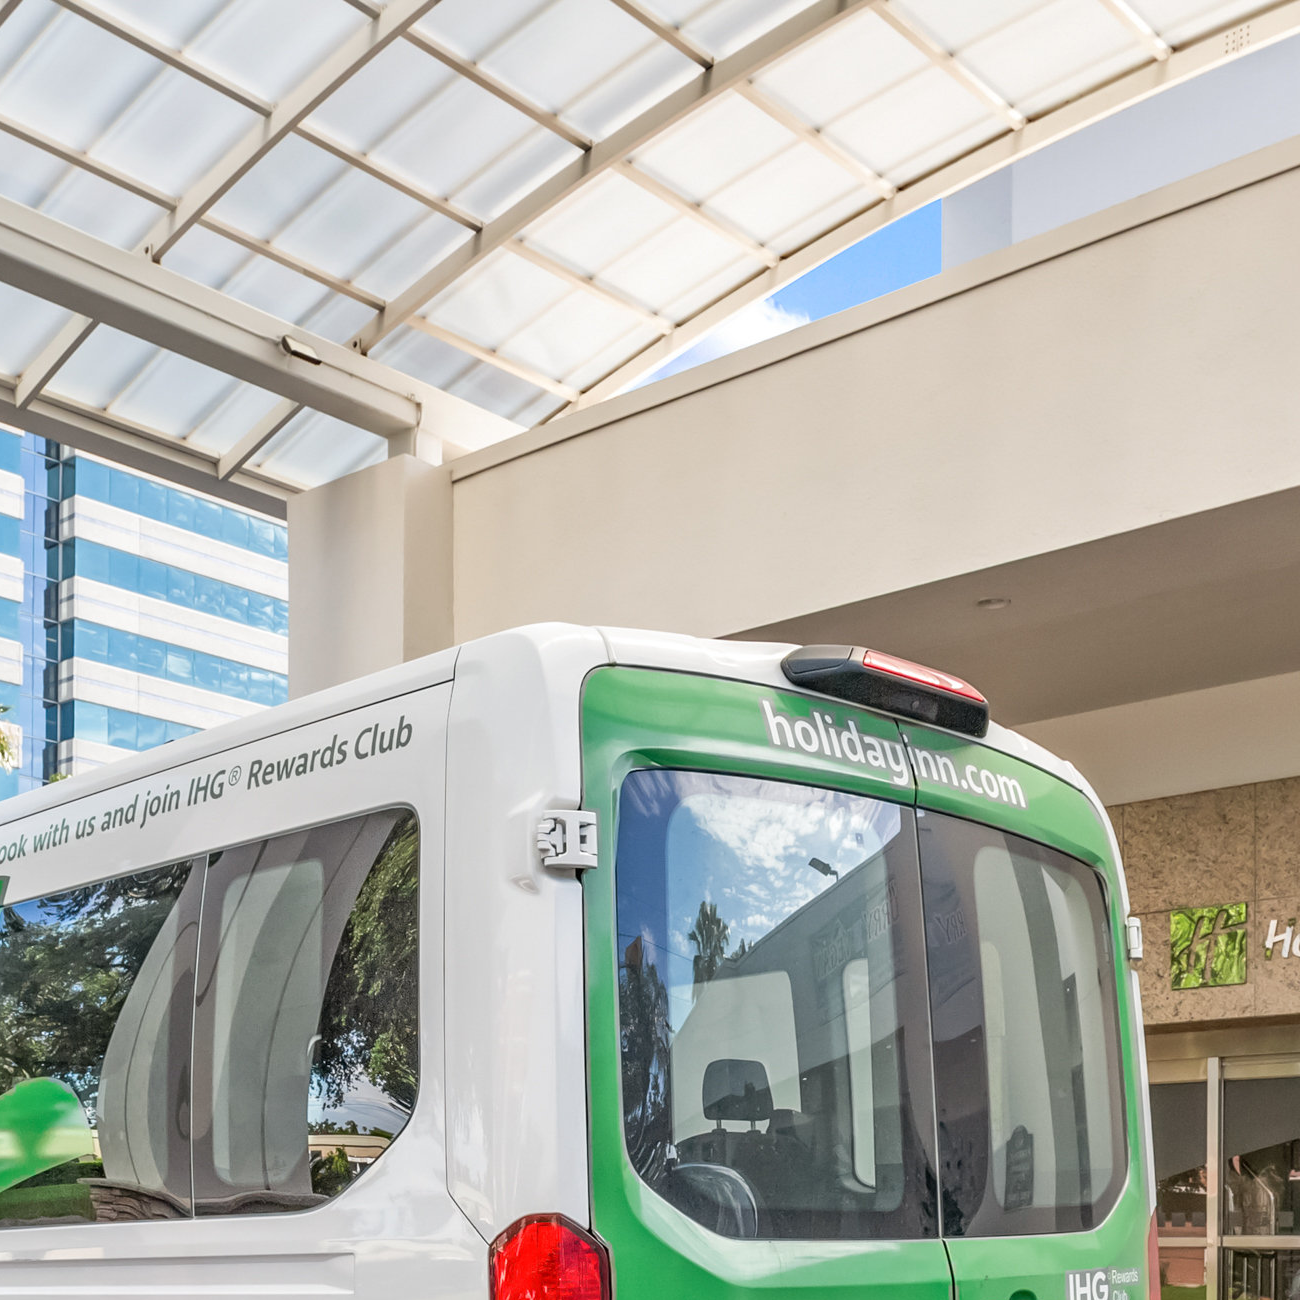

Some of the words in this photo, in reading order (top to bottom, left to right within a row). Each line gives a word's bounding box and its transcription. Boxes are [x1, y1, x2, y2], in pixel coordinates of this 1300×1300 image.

[33, 817, 69, 853] with
[75, 813, 95, 837] us
[101, 794, 136, 832] and
[140, 783, 180, 829] join
[247, 734, 349, 790] Rewards
[354, 715, 413, 760] Club
[762, 699, 1027, 808] holidayinn.com
[1111, 1268, 1139, 1285] Rewards
